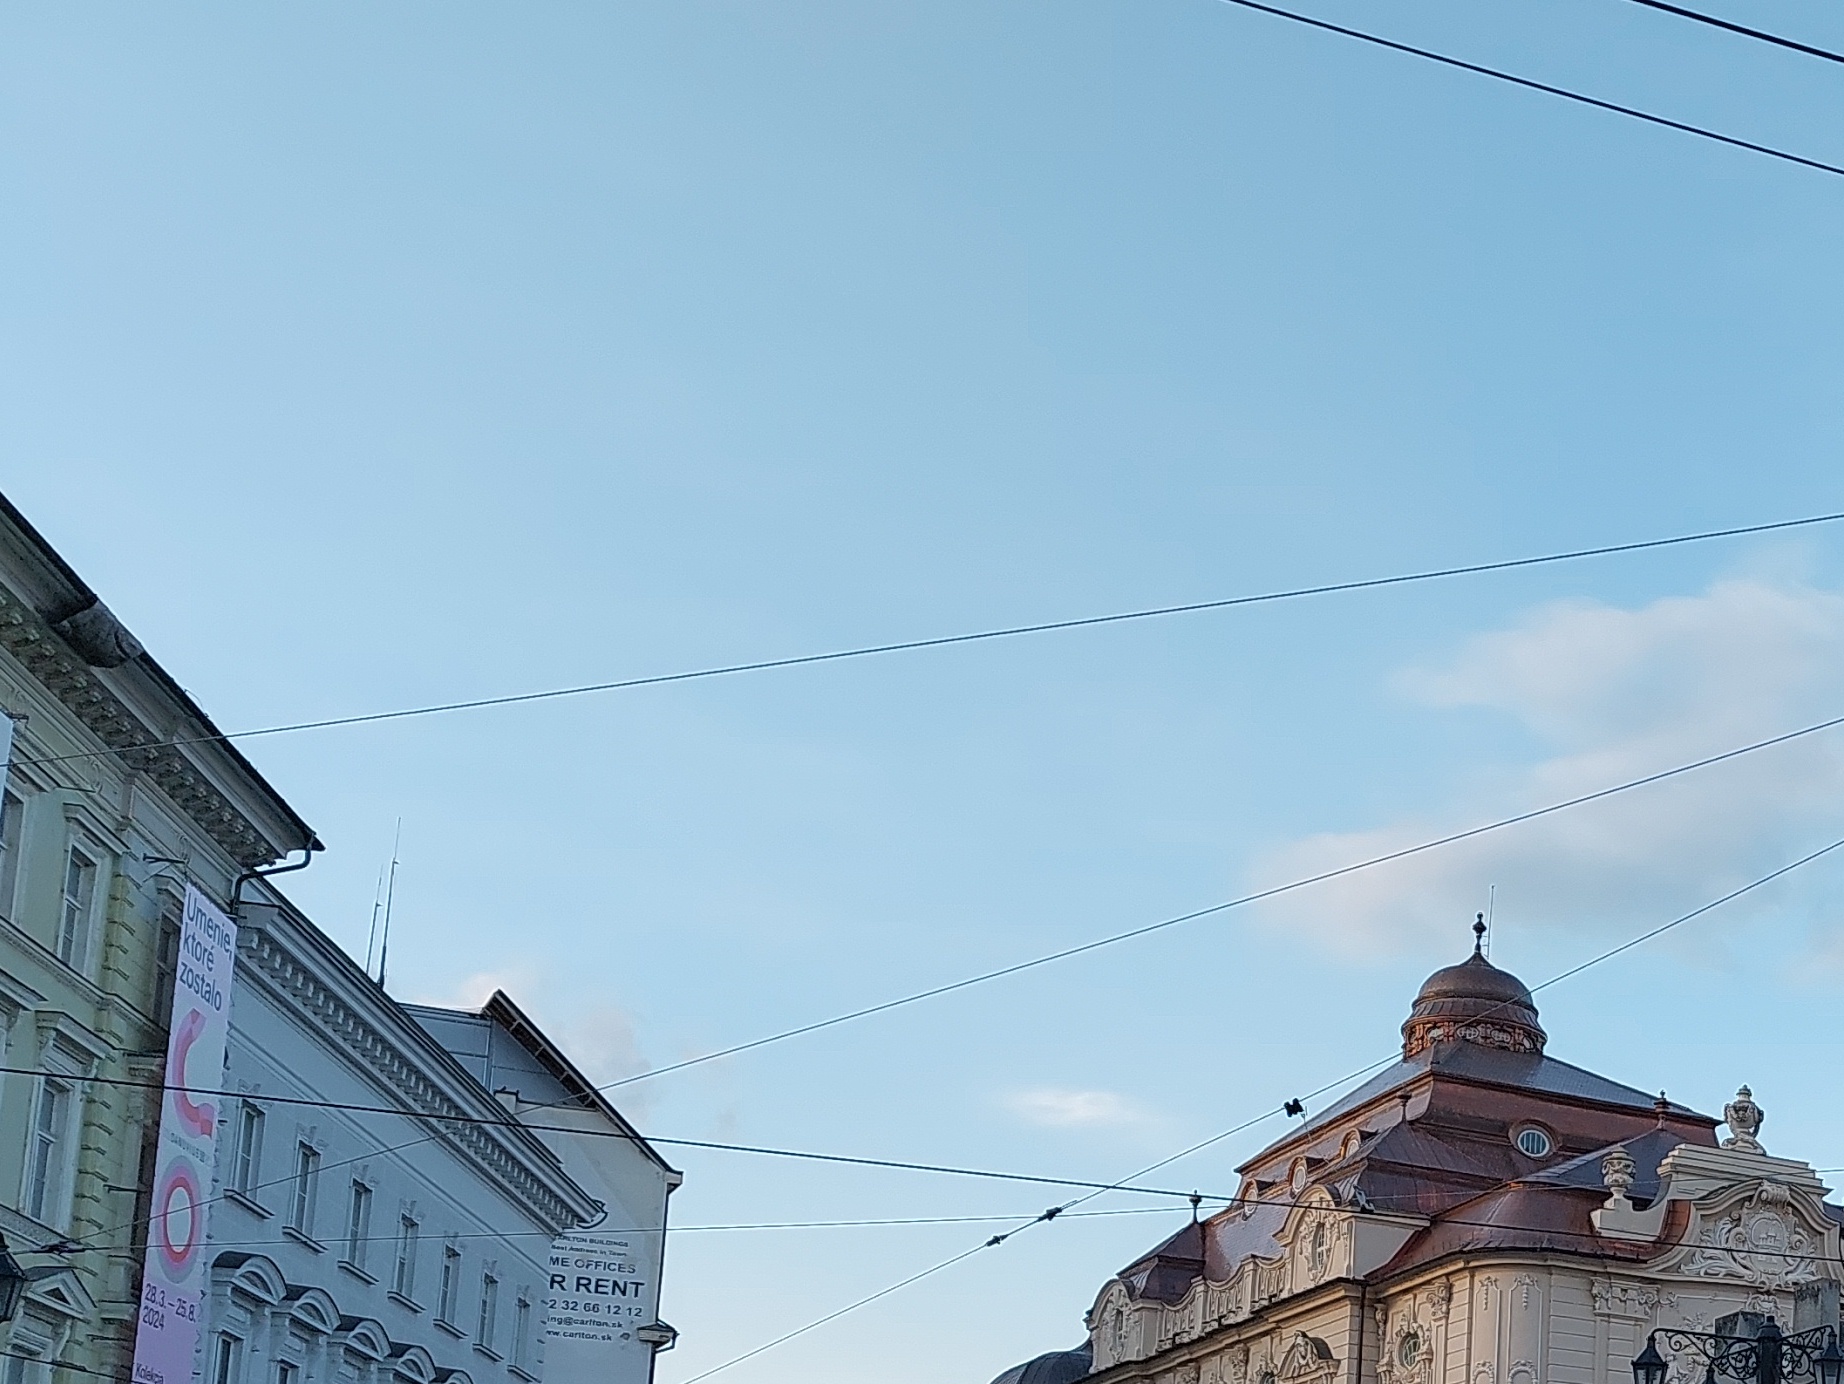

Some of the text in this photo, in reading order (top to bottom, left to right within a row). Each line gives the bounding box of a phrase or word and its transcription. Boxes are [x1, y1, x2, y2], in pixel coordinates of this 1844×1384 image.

[187, 892, 233, 961] Umenie,
[182, 921, 215, 972] ktoré
[180, 961, 222, 1012] zostalo
[589, 1238, 629, 1248] BUILDINGS
[574, 1258, 637, 1275] OFFICES
[575, 1276, 645, 1299] RENT
[142, 1305, 165, 1331] 2024
[561, 1300, 579, 1311] 32
[583, 1302, 600, 1313] 66
[605, 1304, 621, 1315] 12
[626, 1307, 642, 1317] 12
